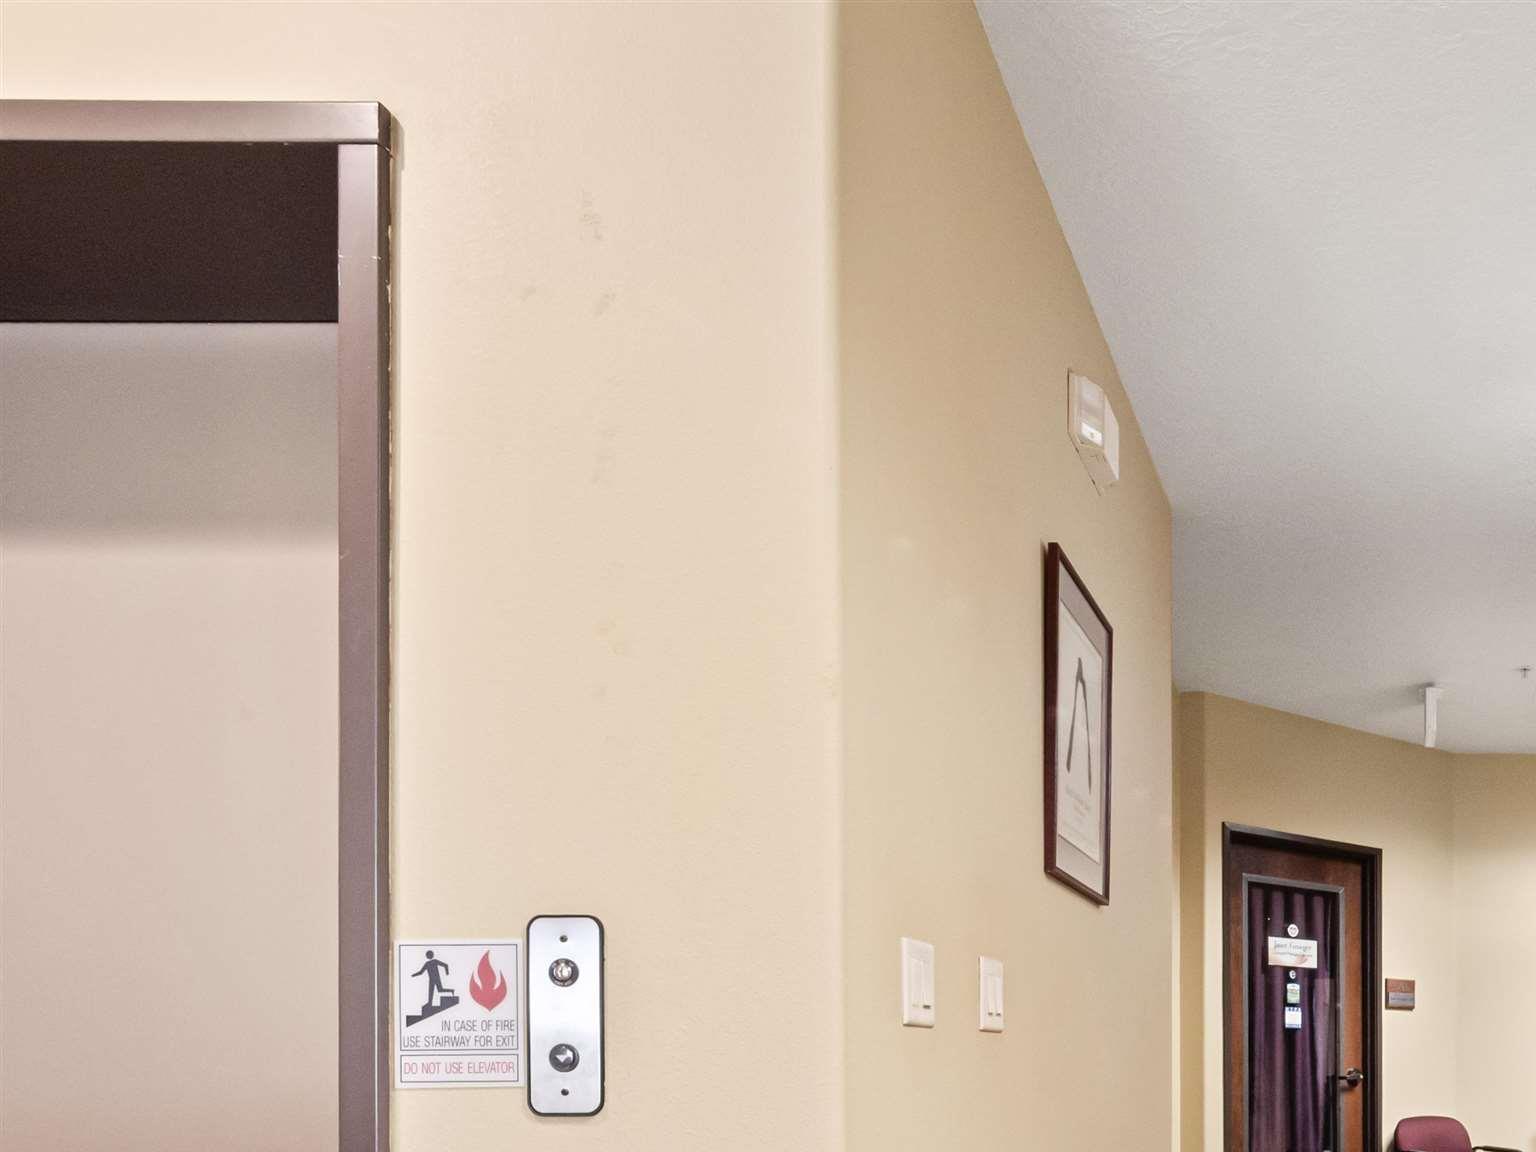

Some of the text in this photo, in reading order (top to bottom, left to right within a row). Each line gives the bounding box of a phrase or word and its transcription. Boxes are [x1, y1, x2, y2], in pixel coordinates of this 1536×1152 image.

[441, 1020, 515, 1032] IN CASE OF FIRE
[403, 1035, 515, 1048] USE STAIRWAY FOR EXIT
[404, 1061, 515, 1074] DO NOT USE ELEVATOR
